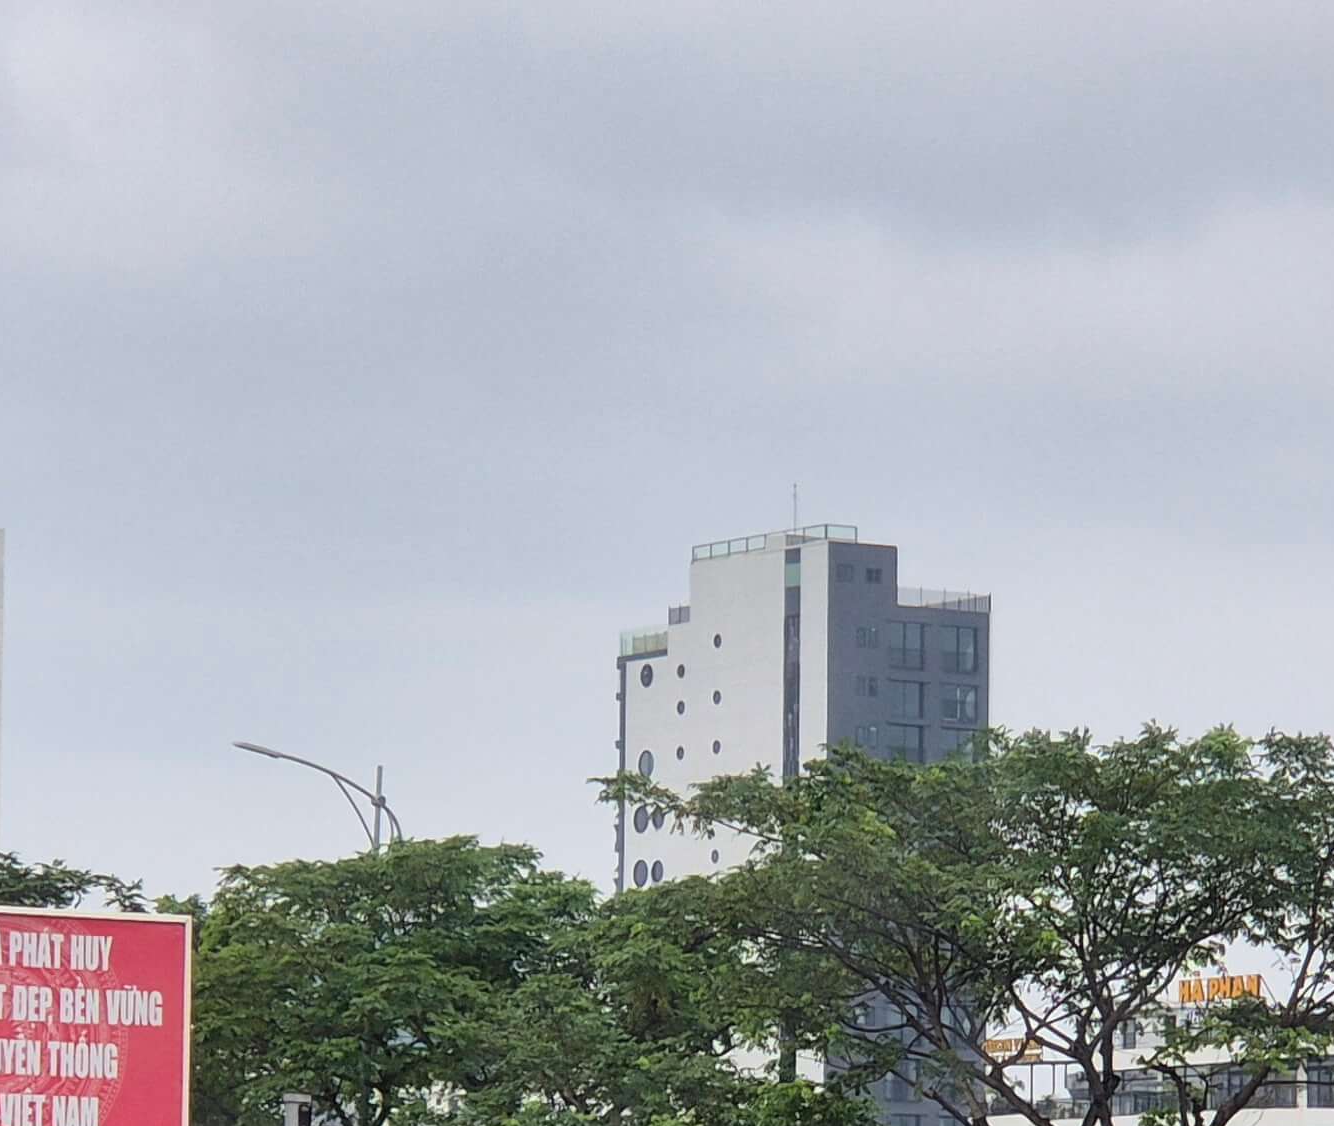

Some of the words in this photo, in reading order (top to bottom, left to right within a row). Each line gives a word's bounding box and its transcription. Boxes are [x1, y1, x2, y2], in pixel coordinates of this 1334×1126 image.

[9, 927, 65, 970] PHÁT
[70, 934, 113, 972] HUY
[59, 976, 100, 1025] BỀN
[106, 984, 163, 1027] VỮNG
[47, 1029, 118, 1079] THỐNG
